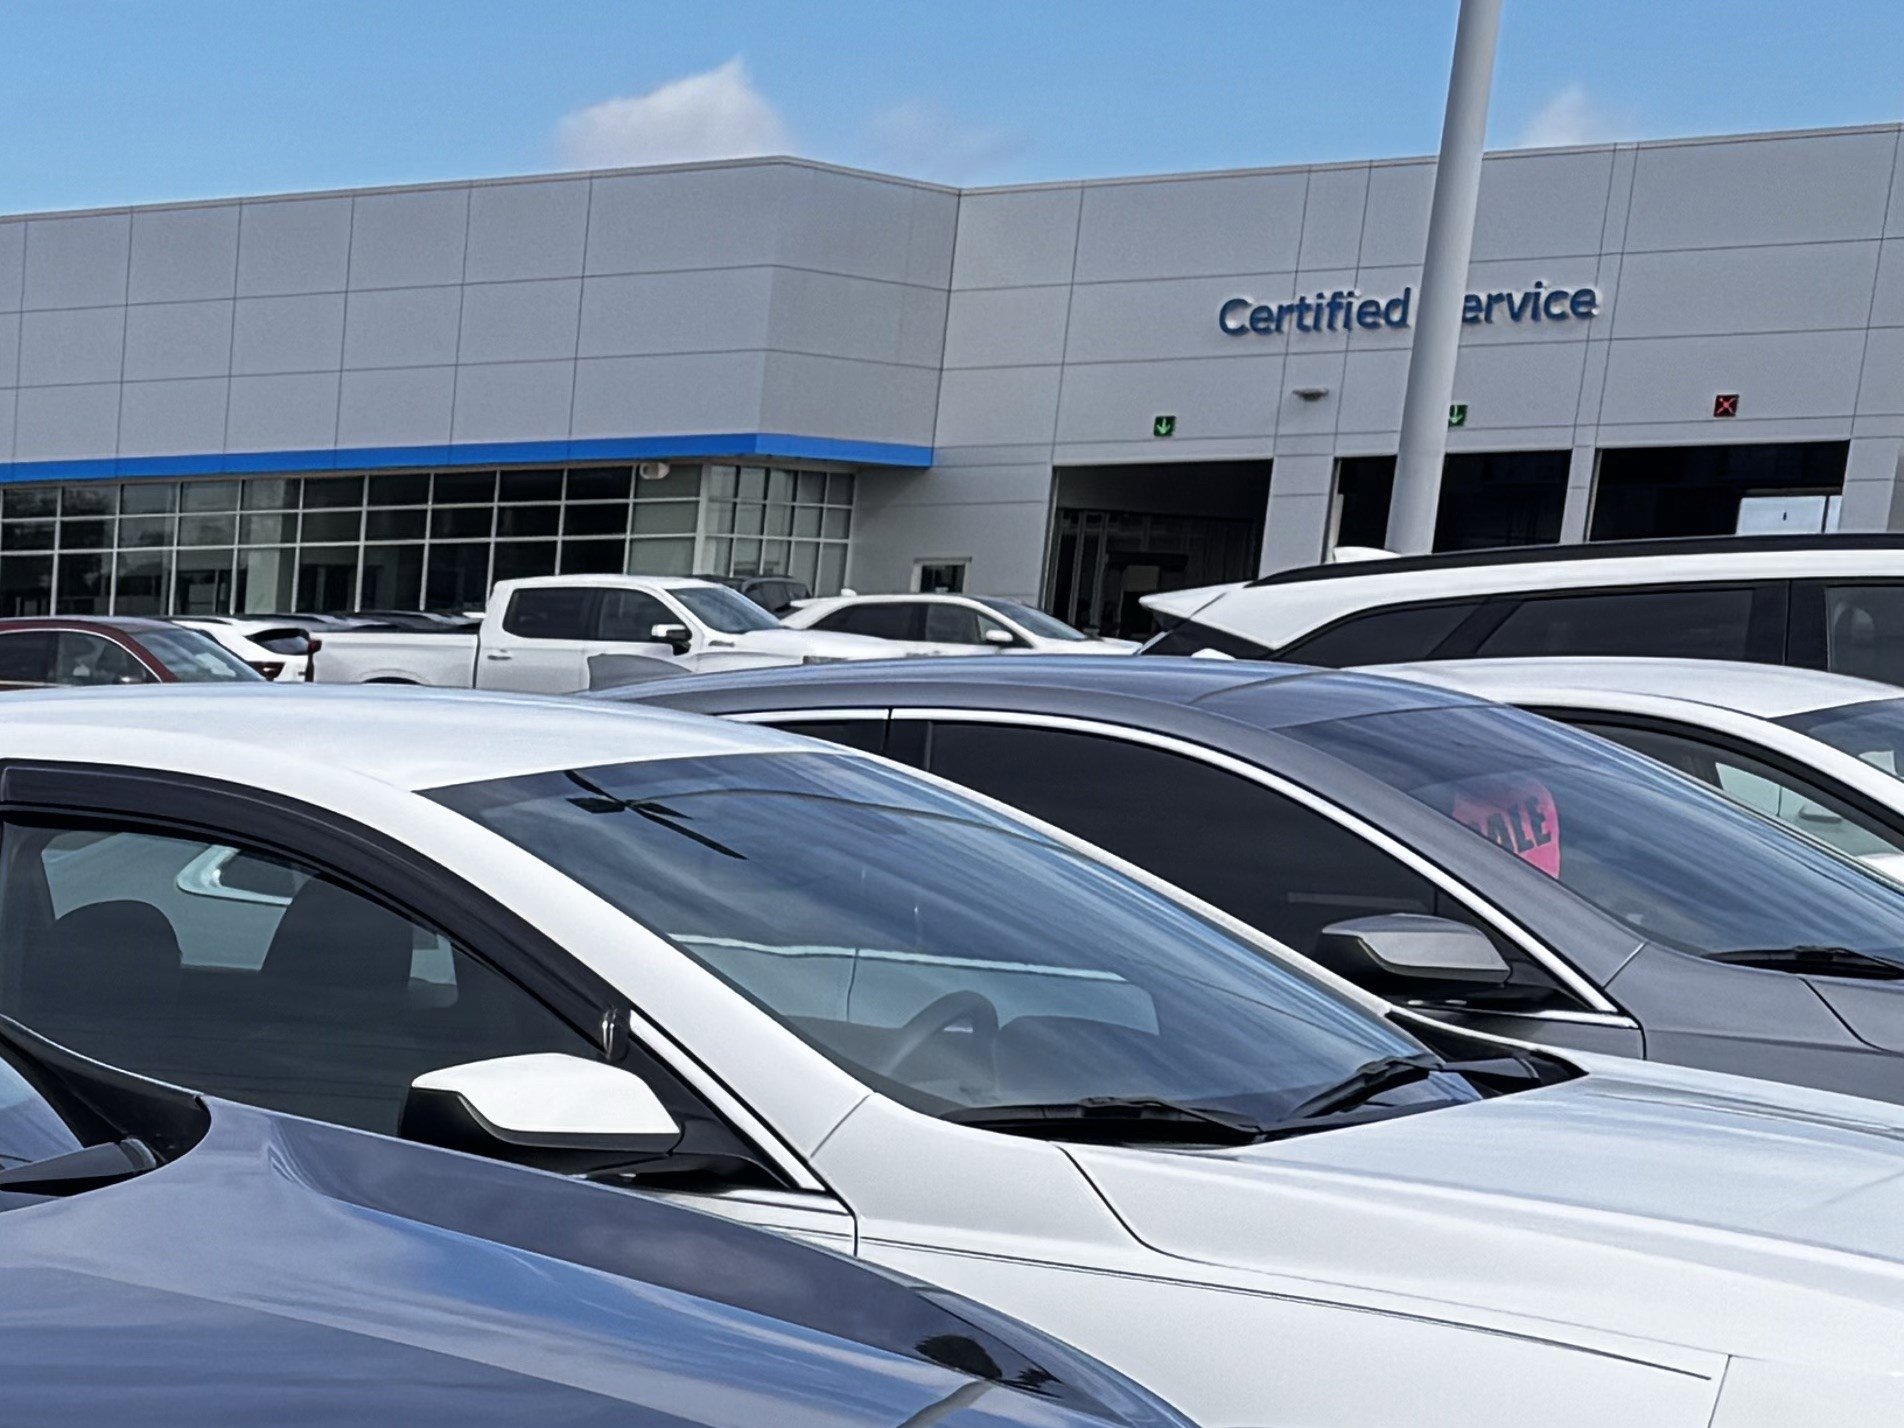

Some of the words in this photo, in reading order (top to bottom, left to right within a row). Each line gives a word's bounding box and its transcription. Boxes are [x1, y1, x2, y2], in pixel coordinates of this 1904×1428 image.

[1218, 286, 1412, 337] Certified
[1458, 280, 1598, 325] ervice
[1478, 796, 1552, 853] ALE
